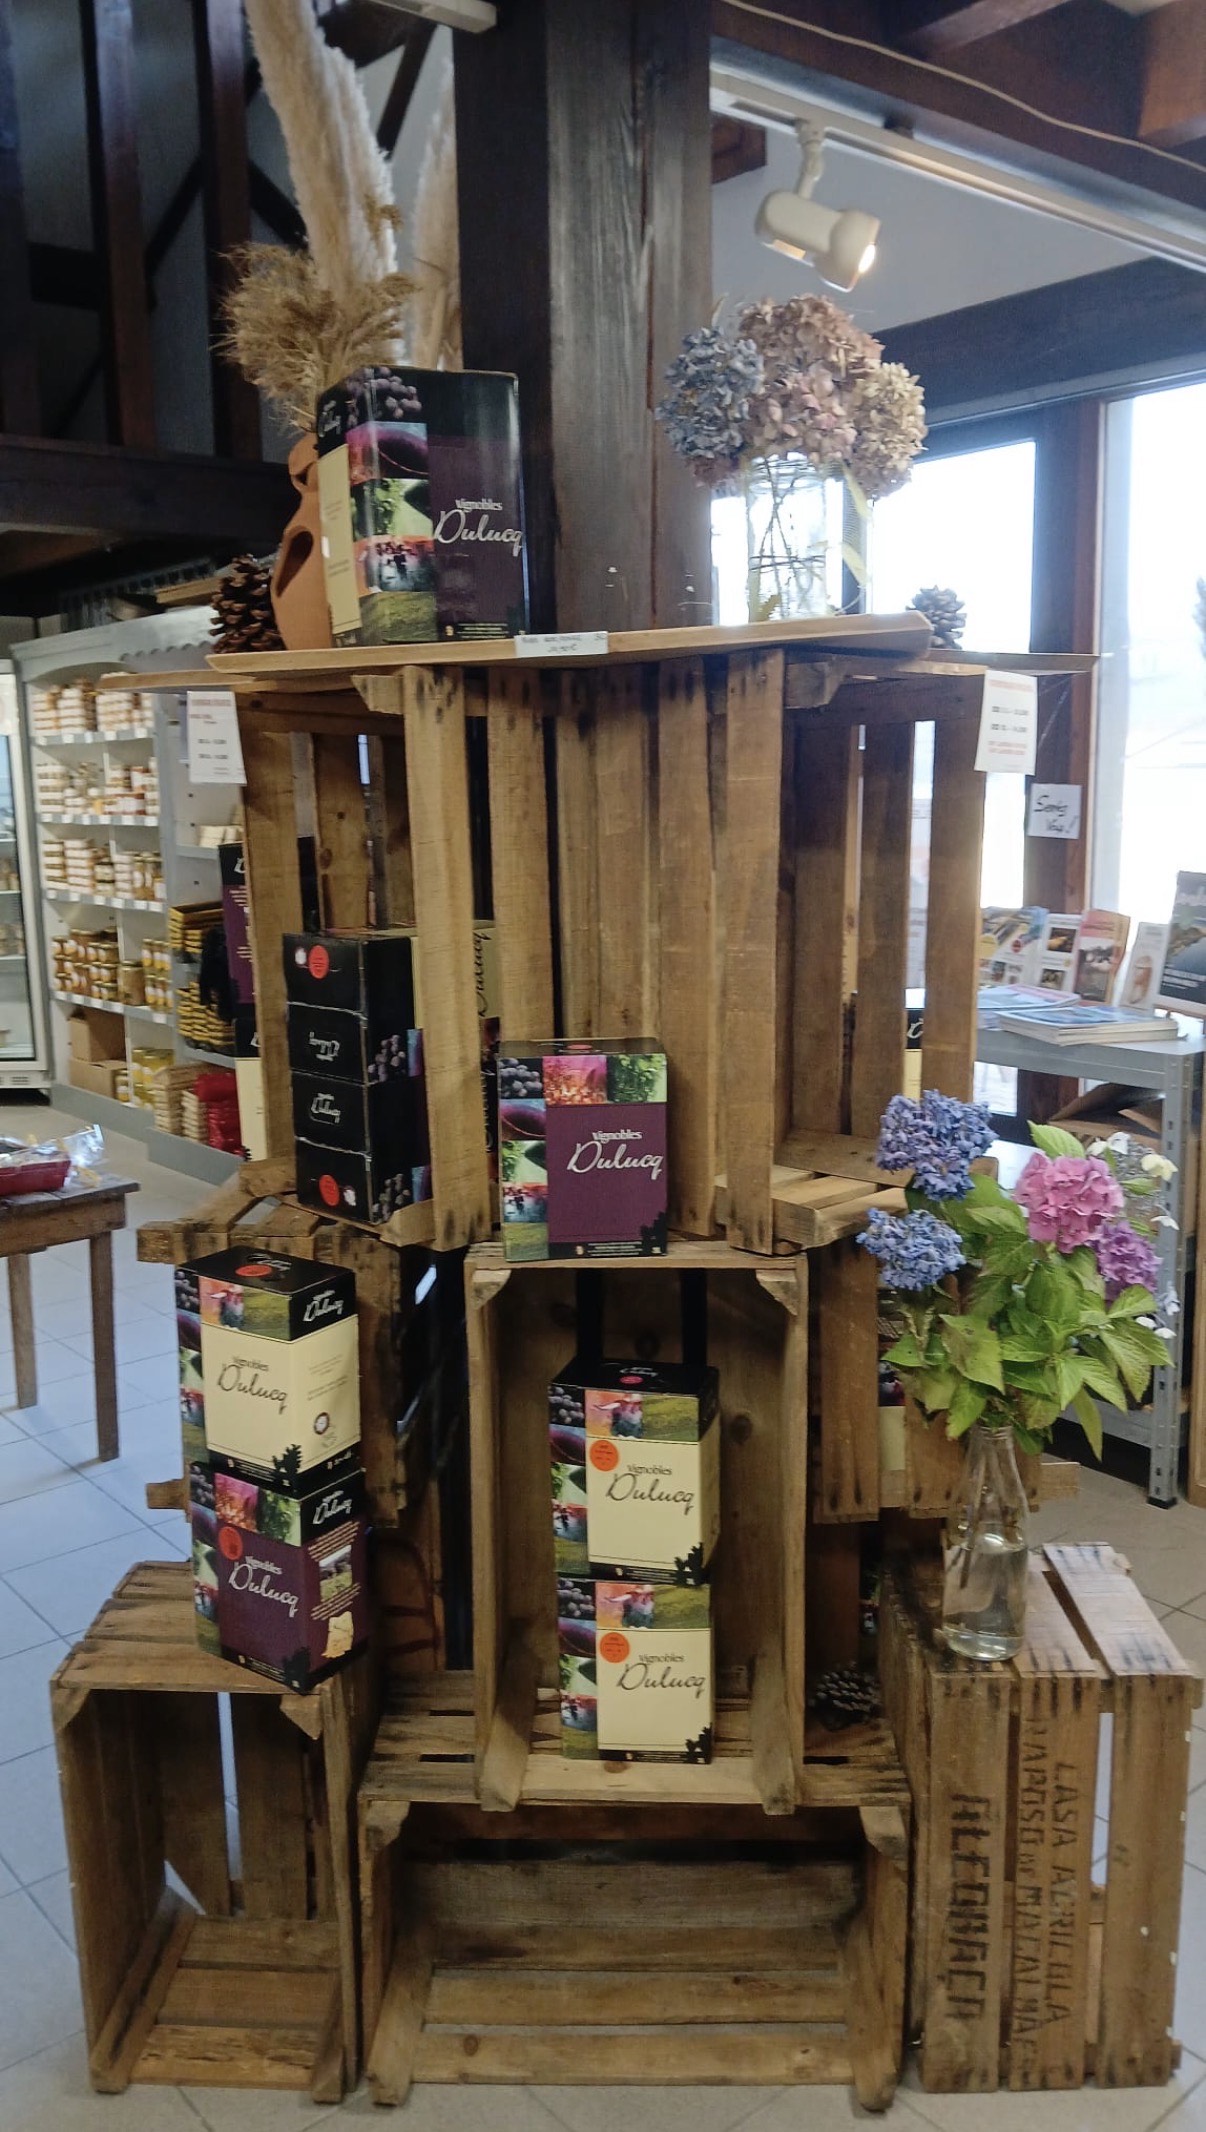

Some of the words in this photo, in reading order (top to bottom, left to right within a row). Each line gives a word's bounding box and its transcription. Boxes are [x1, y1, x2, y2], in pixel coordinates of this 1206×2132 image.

[455, 498, 503, 512] Vignobles
[434, 508, 523, 557] Dulucq
[592, 1129, 643, 1144] Vignobles
[567, 1140, 663, 1180] Dulucq
[217, 1362, 288, 1415] Dulucq
[627, 1464, 673, 1477] Vignobles
[605, 1472, 695, 1516] Dulucq
[245, 1556, 284, 1575] Vignobles
[228, 1562, 300, 1618] Dulucq
[639, 1654, 686, 1666] Vignobles
[616, 1662, 706, 1698] Dulucq
